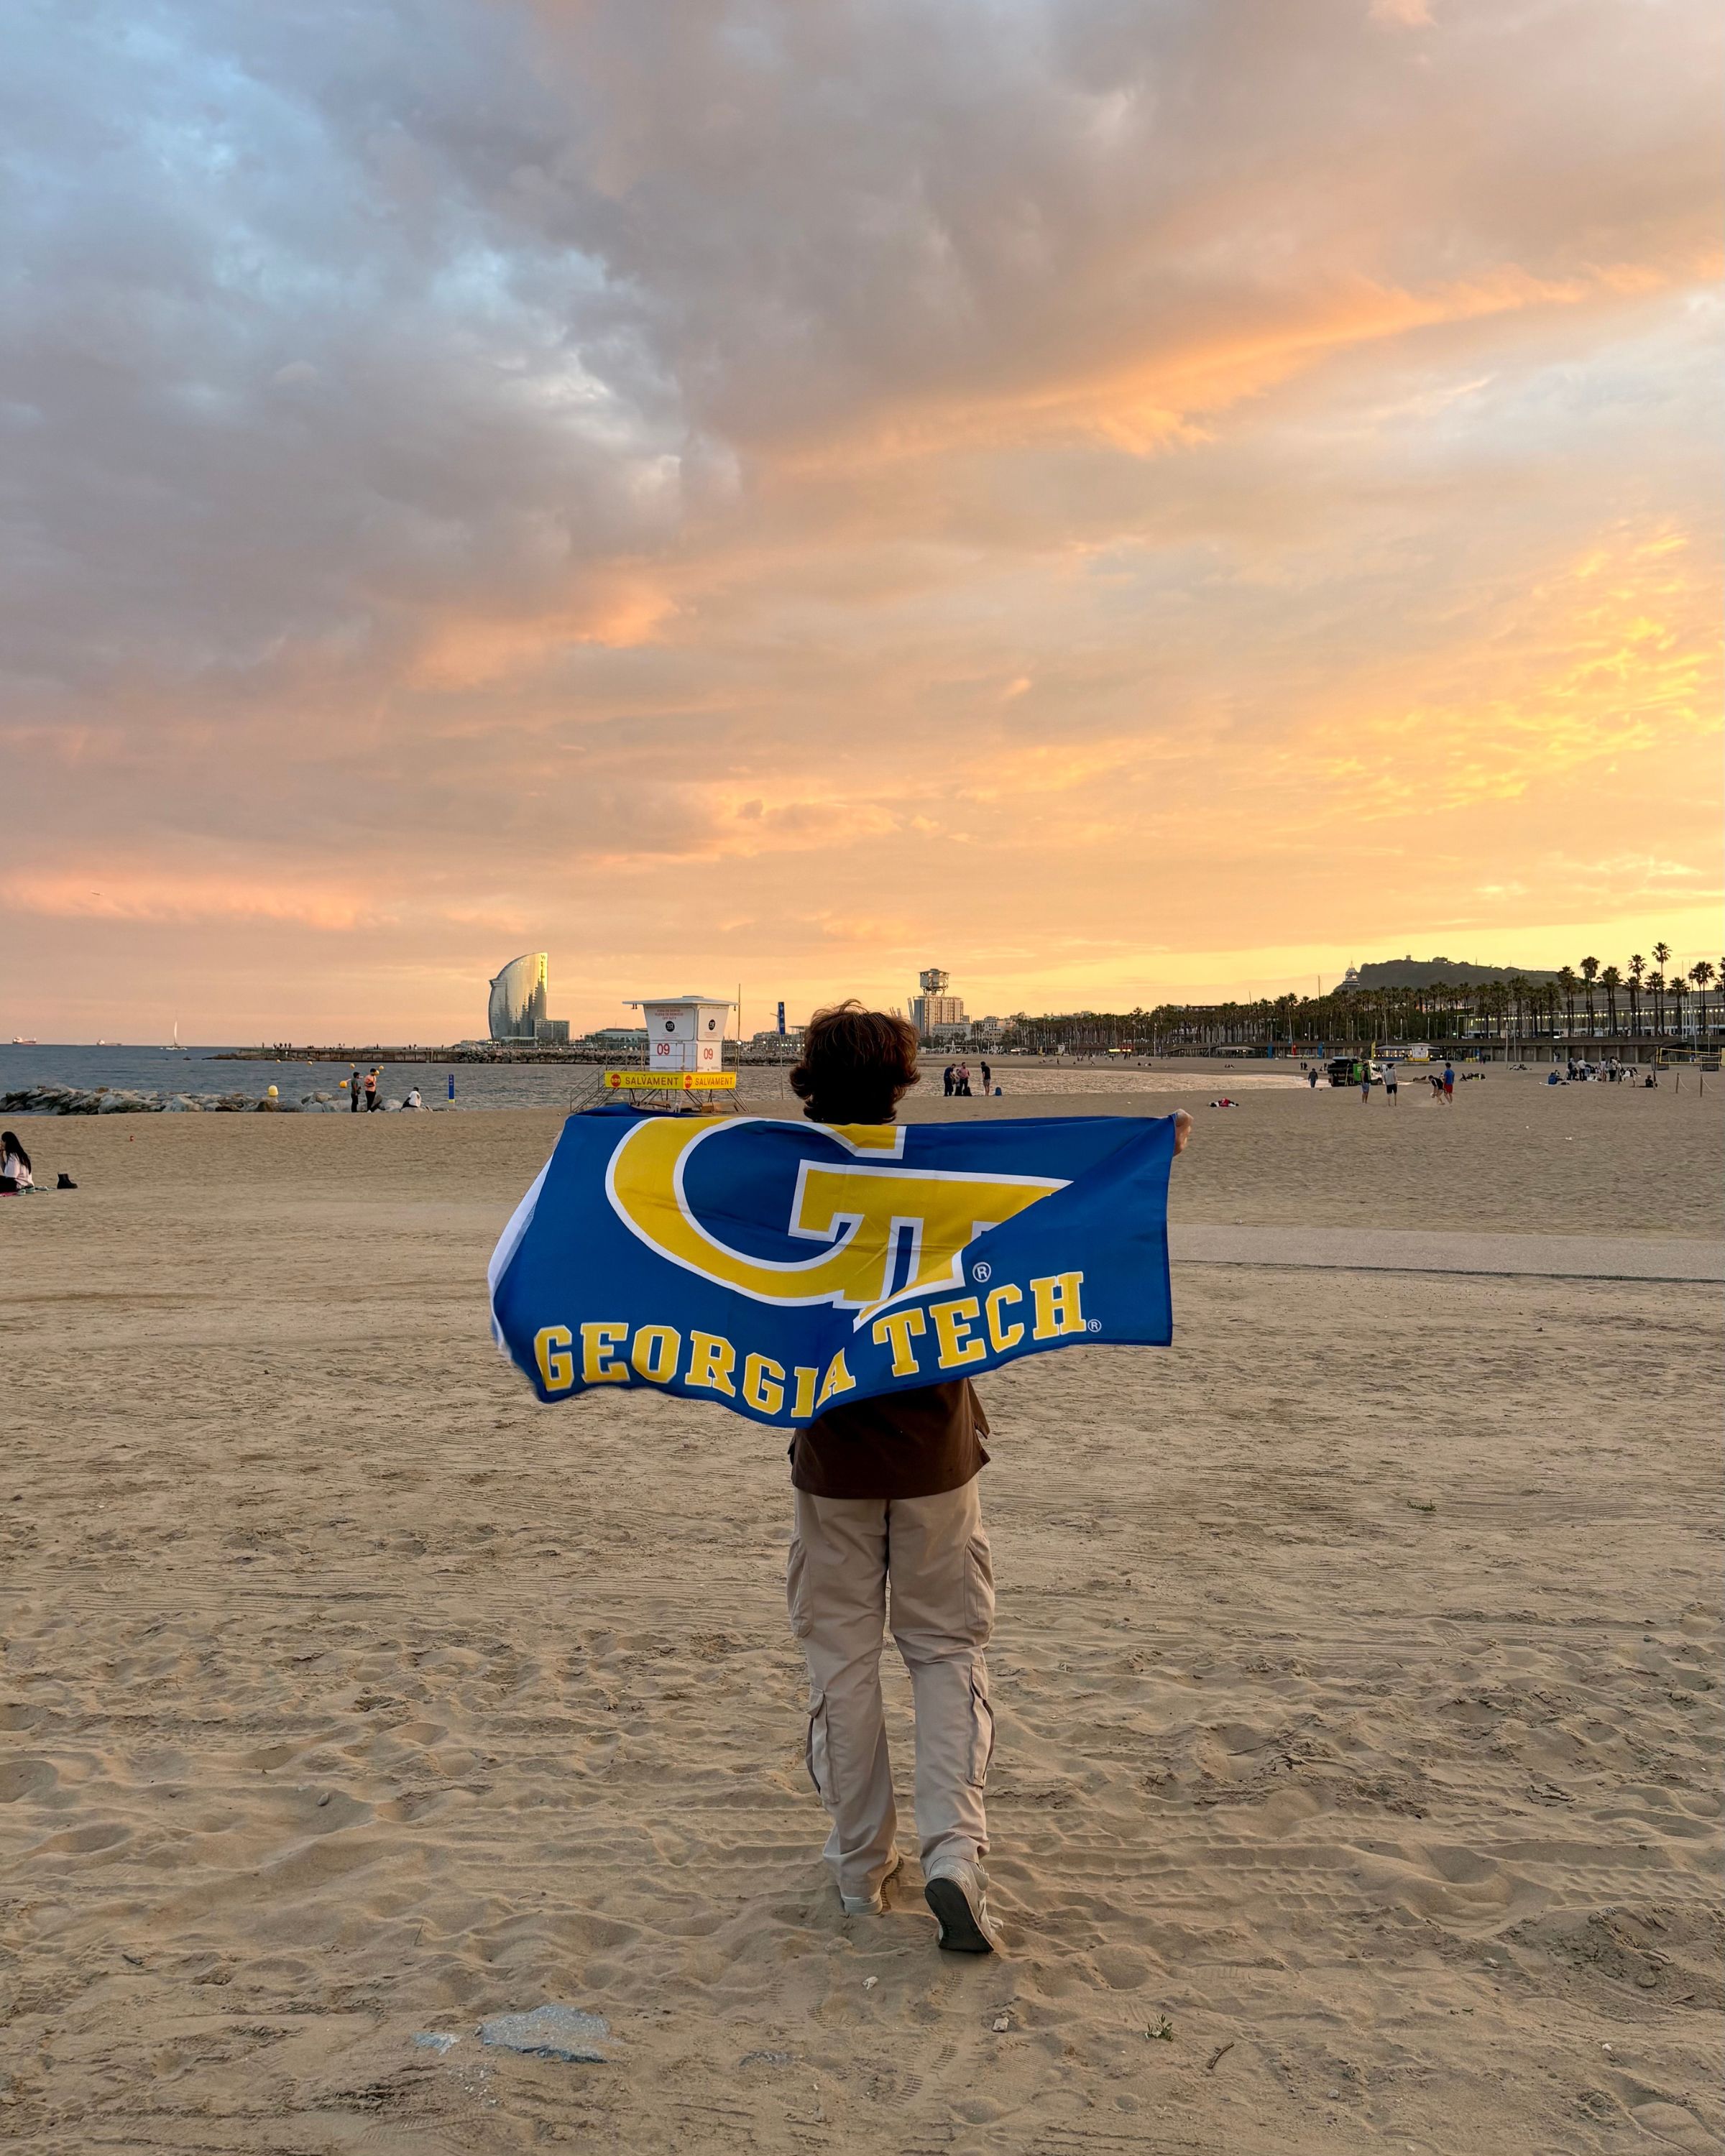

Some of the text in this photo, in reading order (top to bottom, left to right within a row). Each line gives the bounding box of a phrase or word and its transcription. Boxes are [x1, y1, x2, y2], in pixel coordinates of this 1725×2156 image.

[657, 1043, 670, 1056] 09
[704, 1048, 713, 1060] 09
[625, 1077, 678, 1086] SALVAMENT
[695, 1077, 733, 1086] SALVAMENT
[533, 1322, 856, 1418] GEORGIA
[873, 1271, 1087, 1377] TECH
